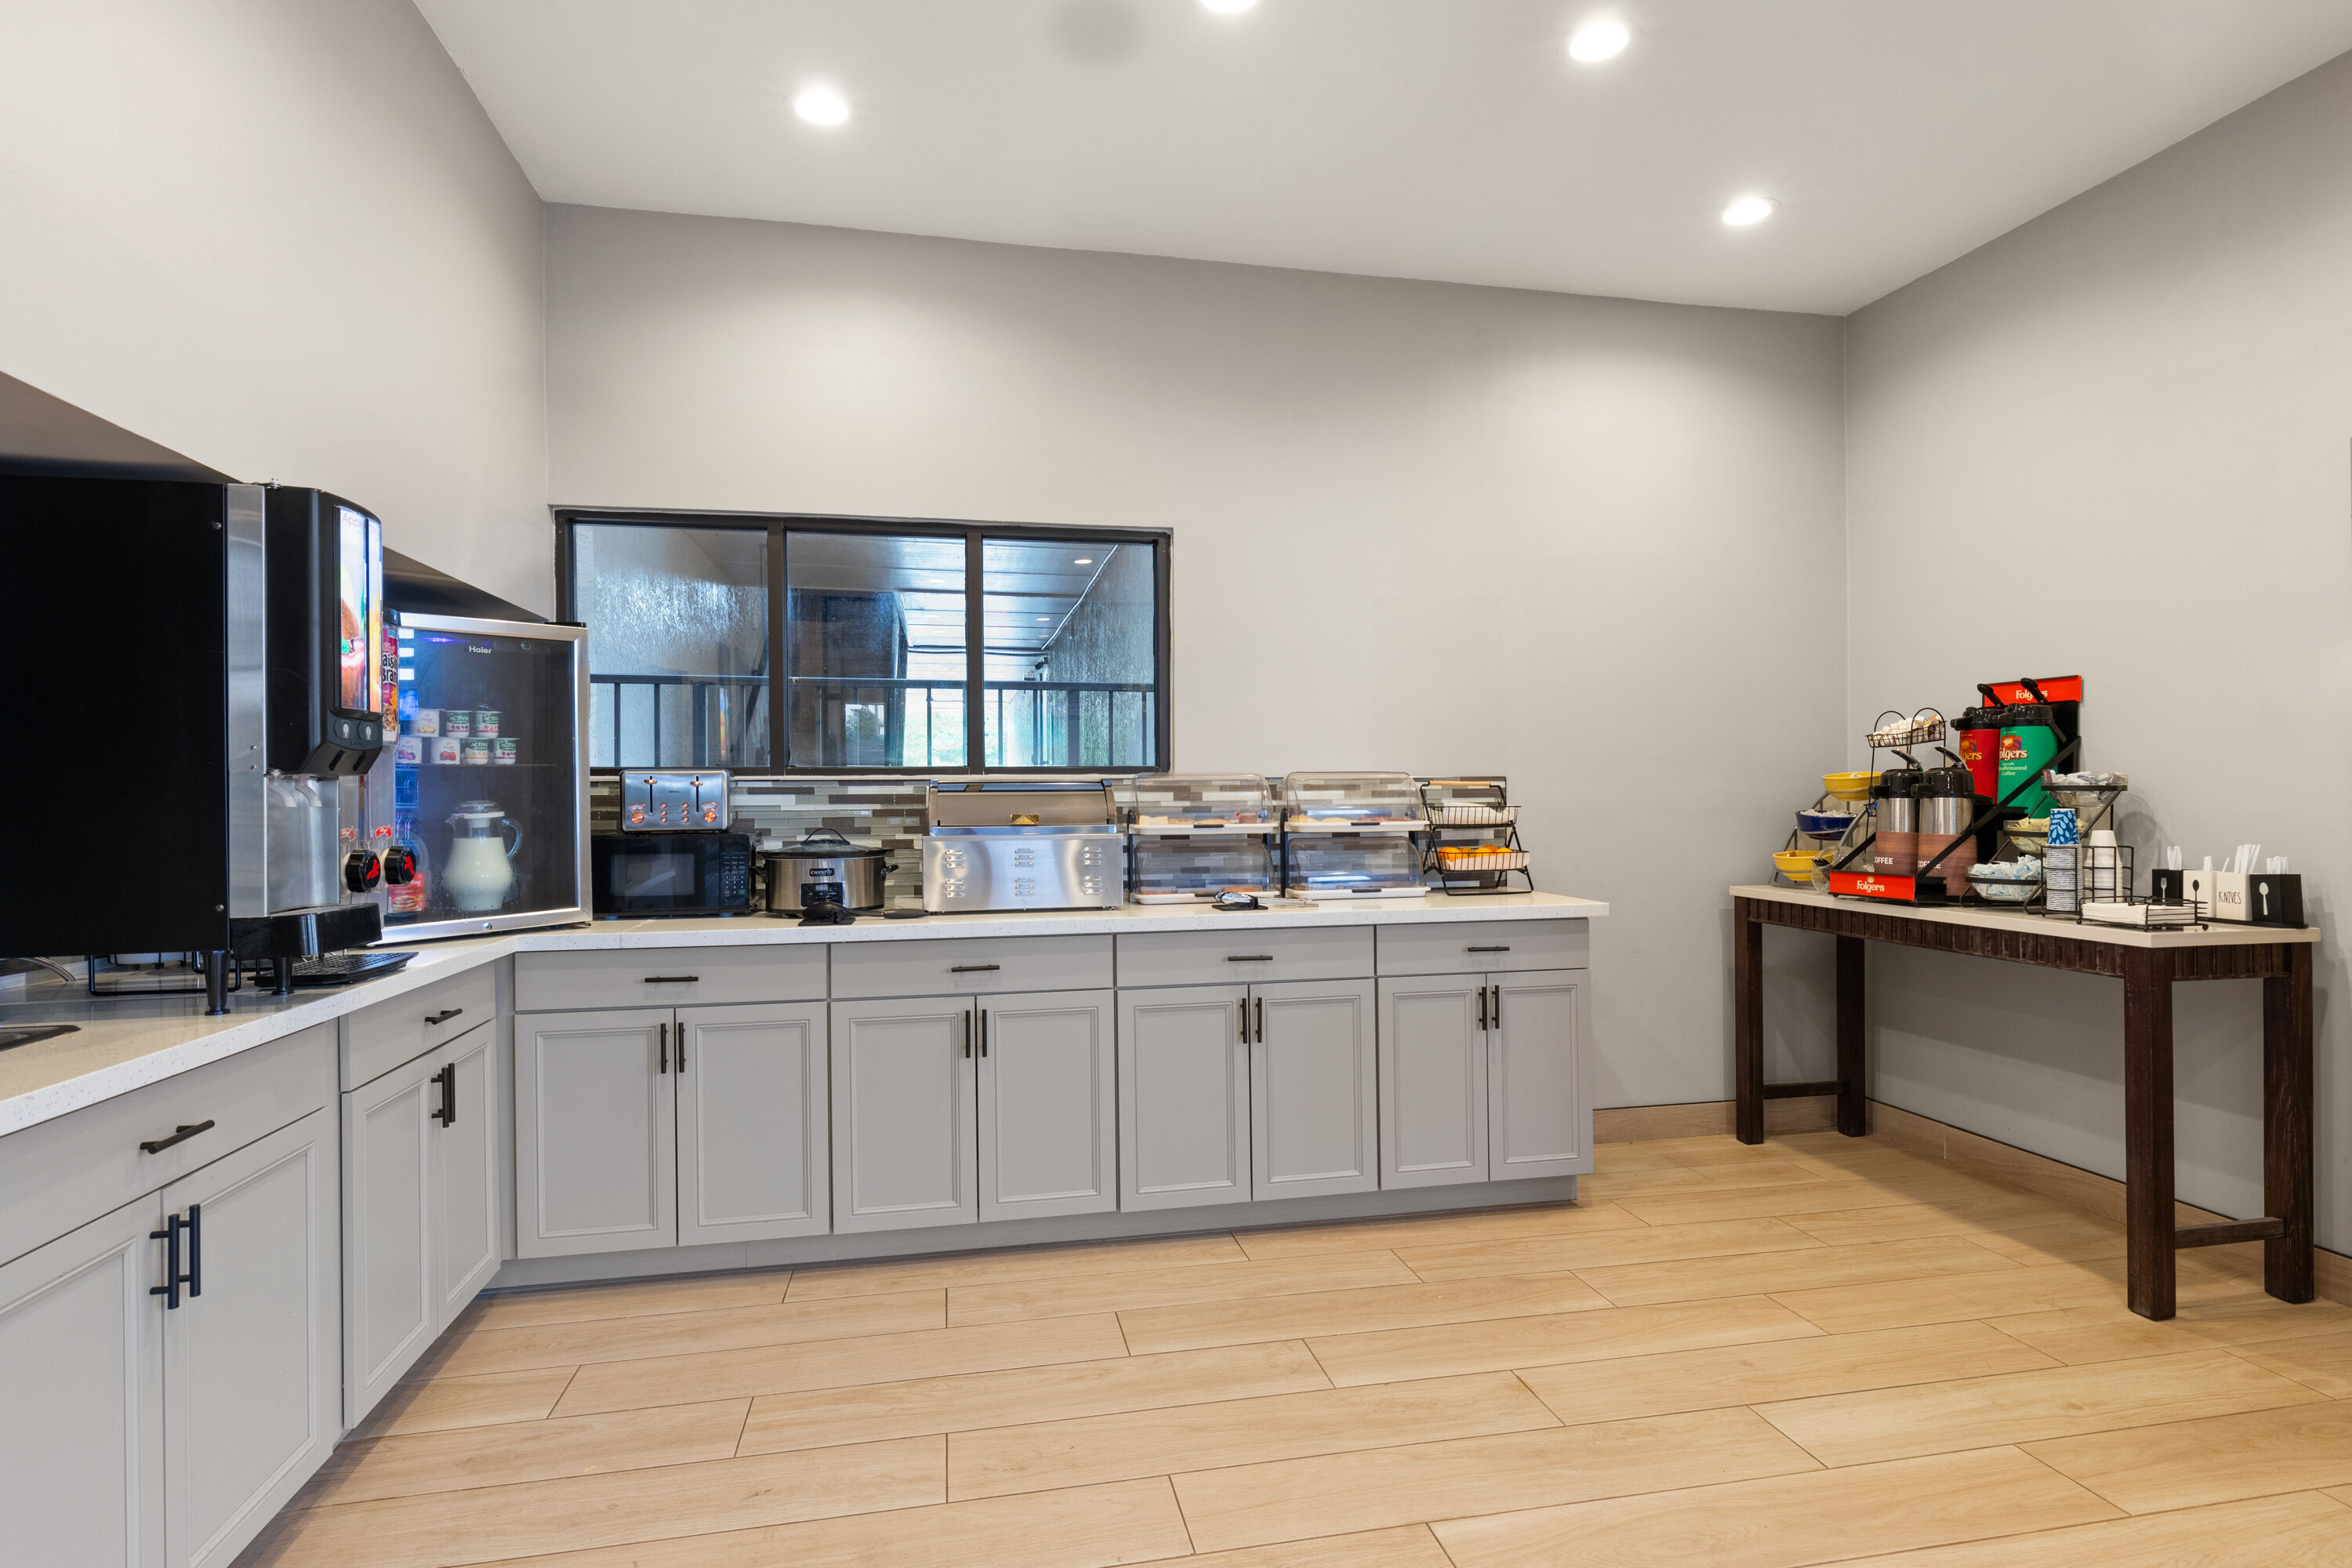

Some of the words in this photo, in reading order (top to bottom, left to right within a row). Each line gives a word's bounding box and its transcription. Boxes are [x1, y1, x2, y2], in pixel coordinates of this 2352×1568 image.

[2016, 689, 2048, 701] Folgs
[1874, 856, 1893, 865] OFFEE
[1857, 880, 1886, 893] Folgers
[2219, 891, 2241, 904] KNIVES
